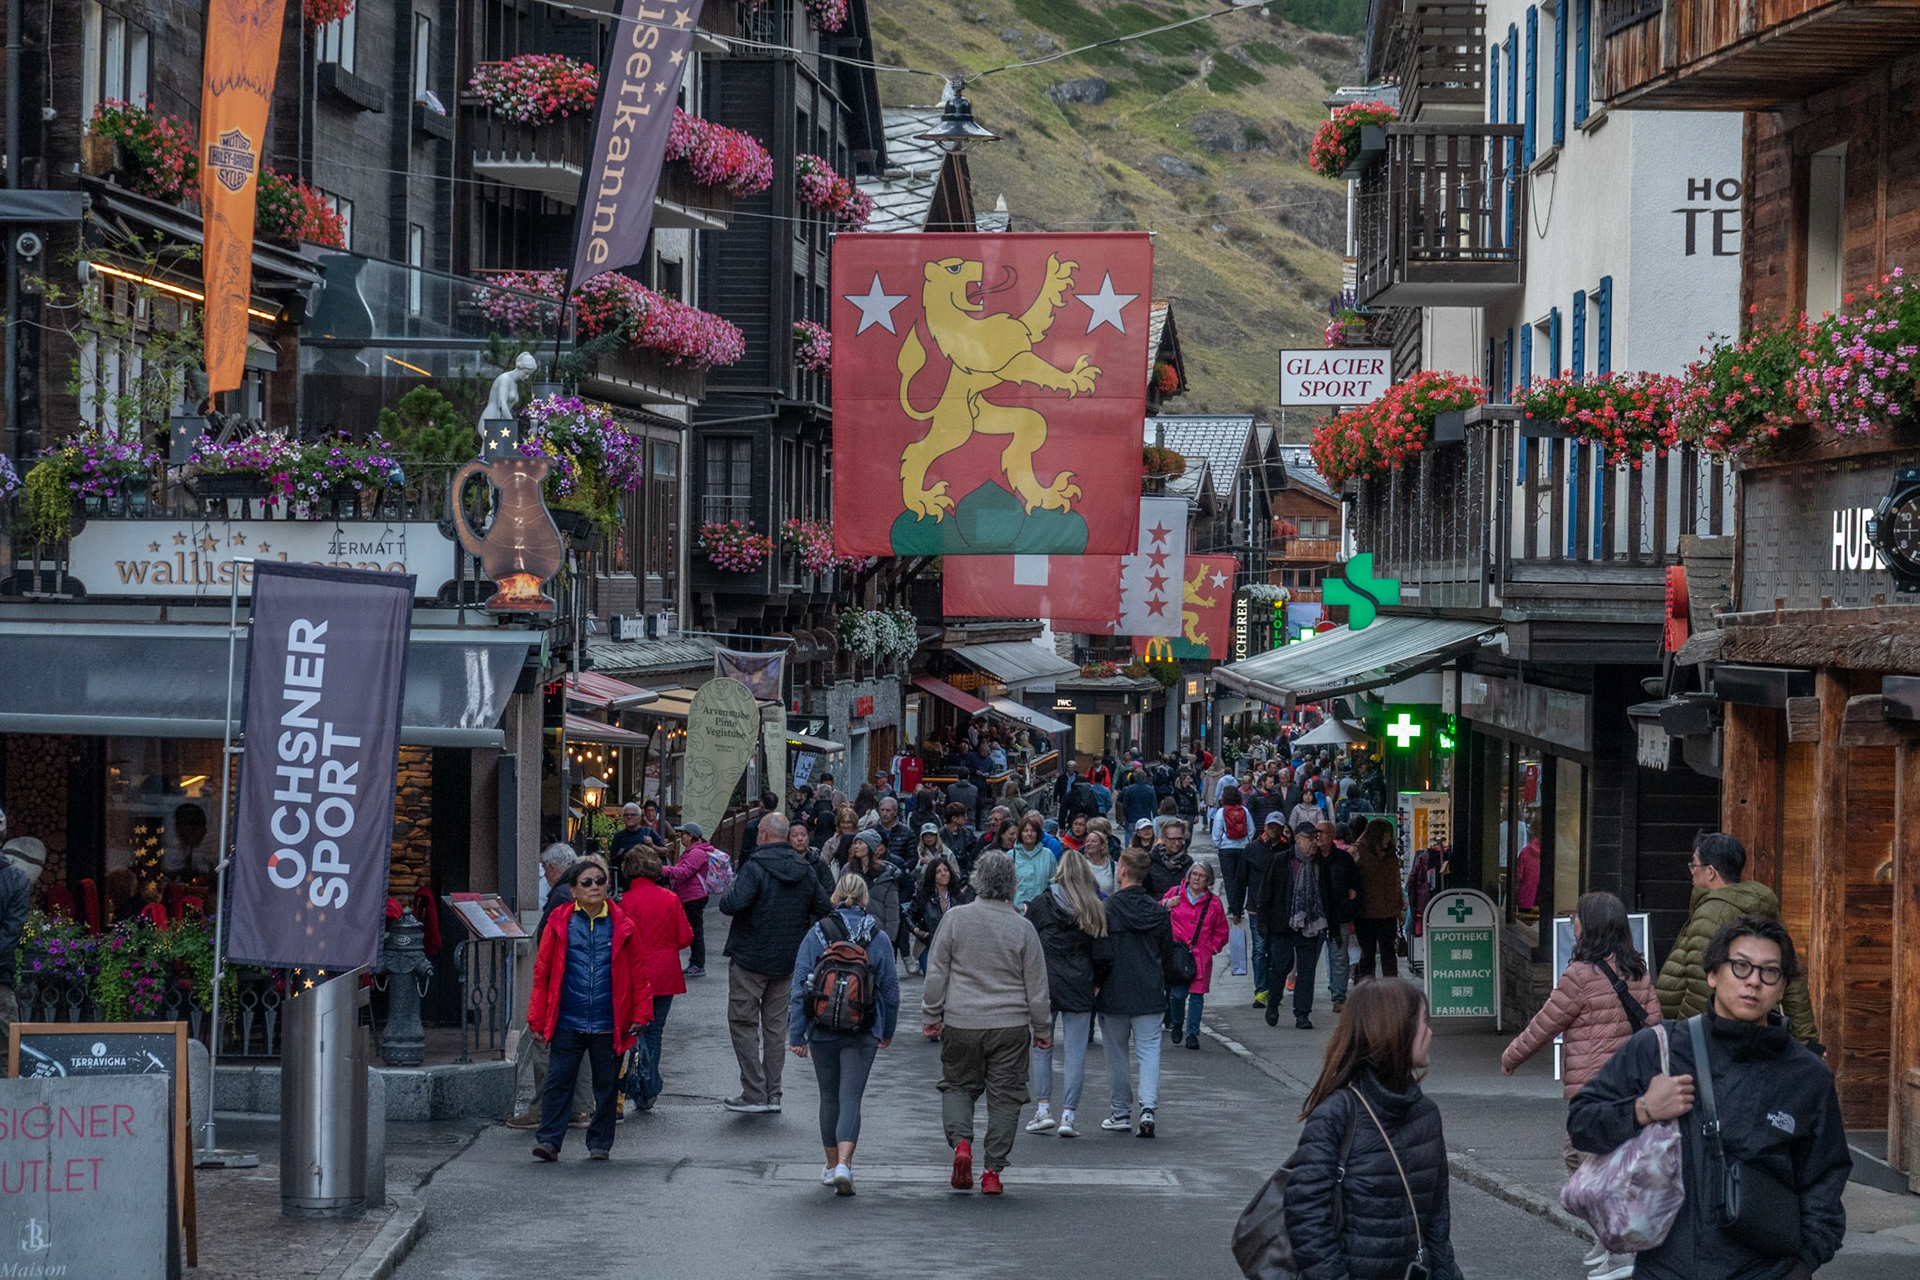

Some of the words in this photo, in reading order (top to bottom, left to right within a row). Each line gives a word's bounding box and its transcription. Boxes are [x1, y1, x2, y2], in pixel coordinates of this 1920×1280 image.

[586, 0, 679, 265] iserkanne
[1687, 177, 1743, 201] HO
[1671, 208, 1742, 256] TE
[1286, 358, 1384, 375] GLACIER
[1299, 380, 1372, 397] SPORT
[328, 541, 405, 555] ZERMATT
[702, 706, 751, 720] Arvenstube
[715, 717, 738, 728] Pinte
[705, 727, 747, 739] Vegistube
[268, 618, 329, 889] OCHSNER
[309, 722, 361, 909] SPORT
[1434, 932, 1489, 942] APOTHEKE
[1433, 969, 1492, 979] PHARMACY
[1436, 1006, 1489, 1015] FARMACIA
[71, 1057, 127, 1067] TERRAVIGNA
[1, 1262, 67, 1278] Maison
